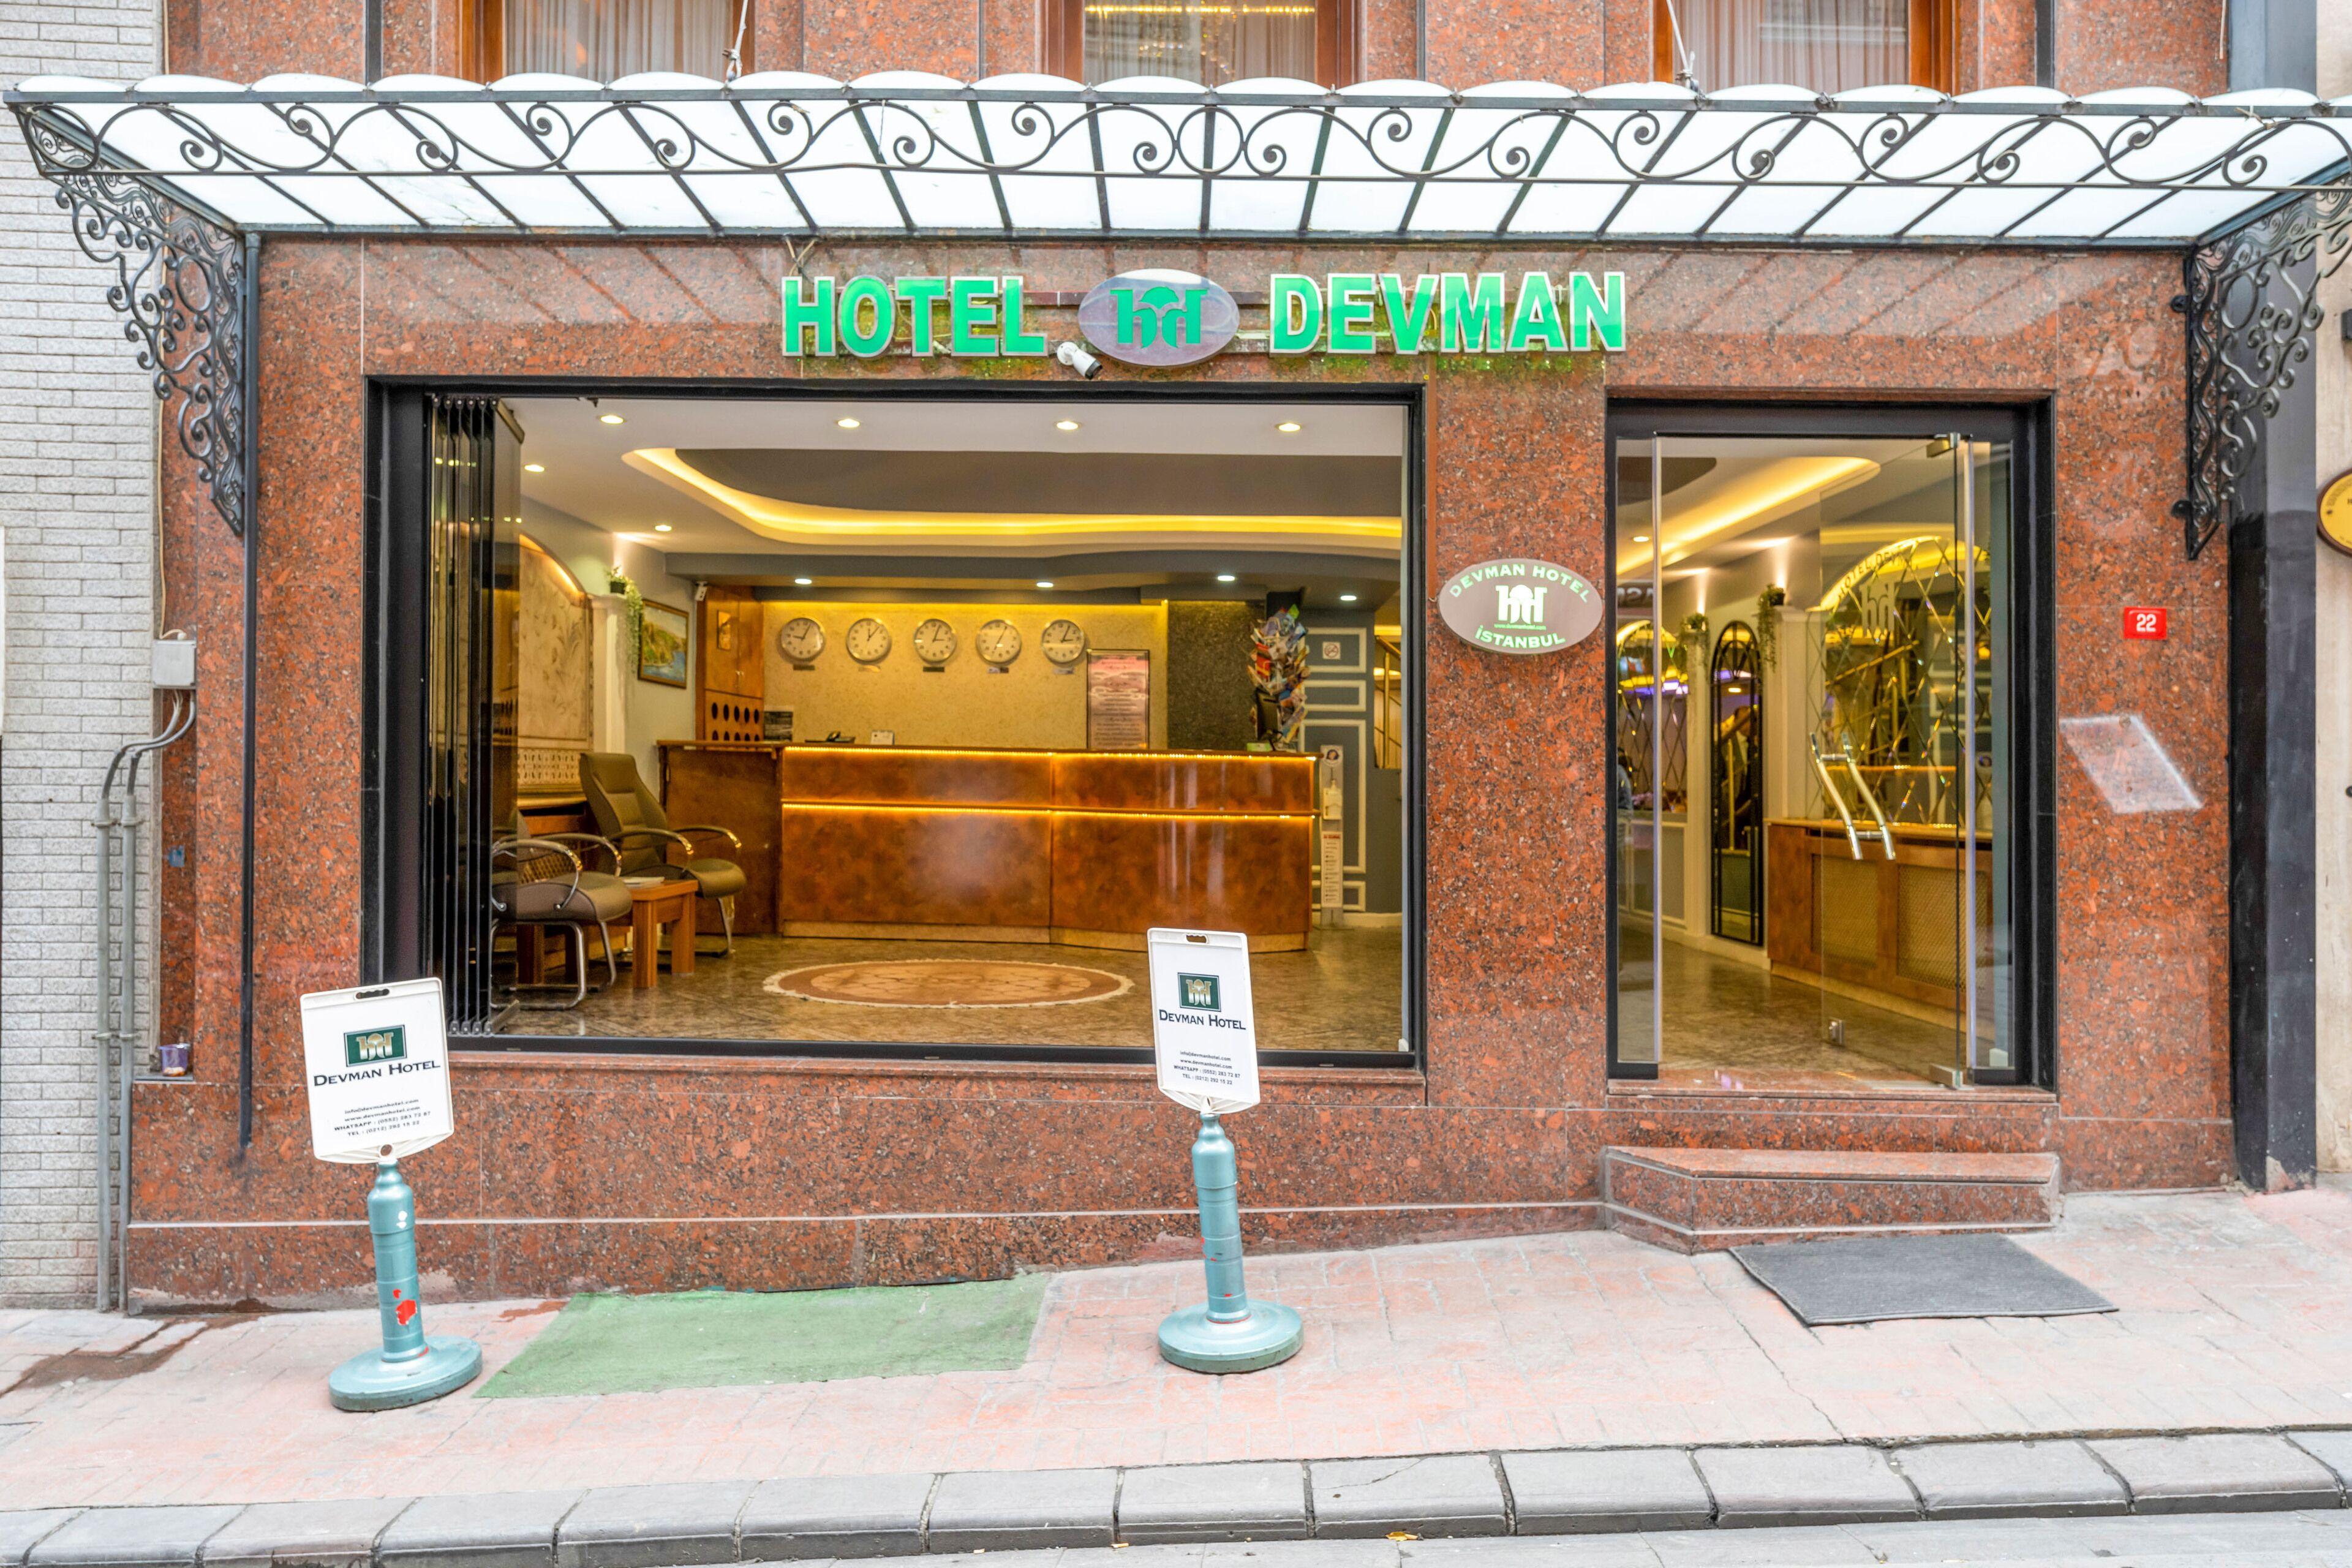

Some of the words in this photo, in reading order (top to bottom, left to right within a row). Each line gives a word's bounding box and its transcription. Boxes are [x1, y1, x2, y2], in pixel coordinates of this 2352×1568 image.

[781, 274, 1049, 358] HOTEL
[1268, 271, 1627, 355] DEVMAN
[1449, 564, 1525, 598] DEVMAN
[1532, 565, 1593, 603] HOTEL
[2136, 613, 2157, 632] 22
[1474, 625, 1566, 649] İSTANBUL
[334, 1121, 372, 1132] WHATSAPP
